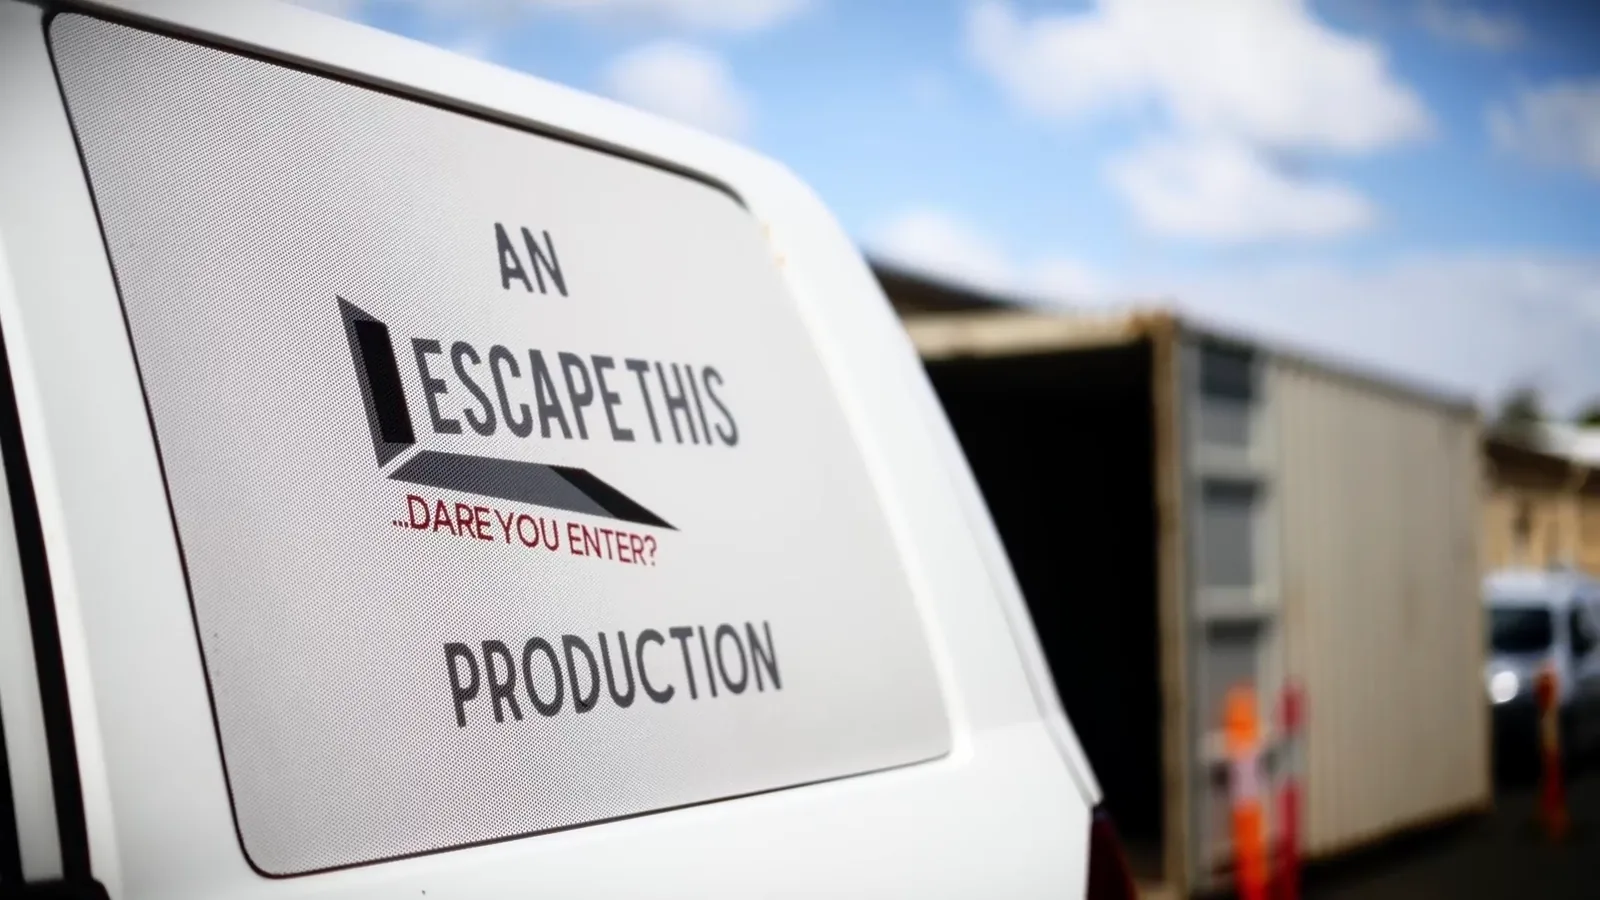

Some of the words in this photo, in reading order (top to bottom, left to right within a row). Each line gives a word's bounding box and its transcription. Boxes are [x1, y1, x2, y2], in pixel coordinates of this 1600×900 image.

[494, 222, 569, 297] AN
[410, 337, 636, 442] ESCAPE
[625, 358, 739, 448] THIS
[493, 510, 560, 552] YOU
[568, 522, 657, 567] ENTER?
[444, 621, 783, 728] PRODUCTION
